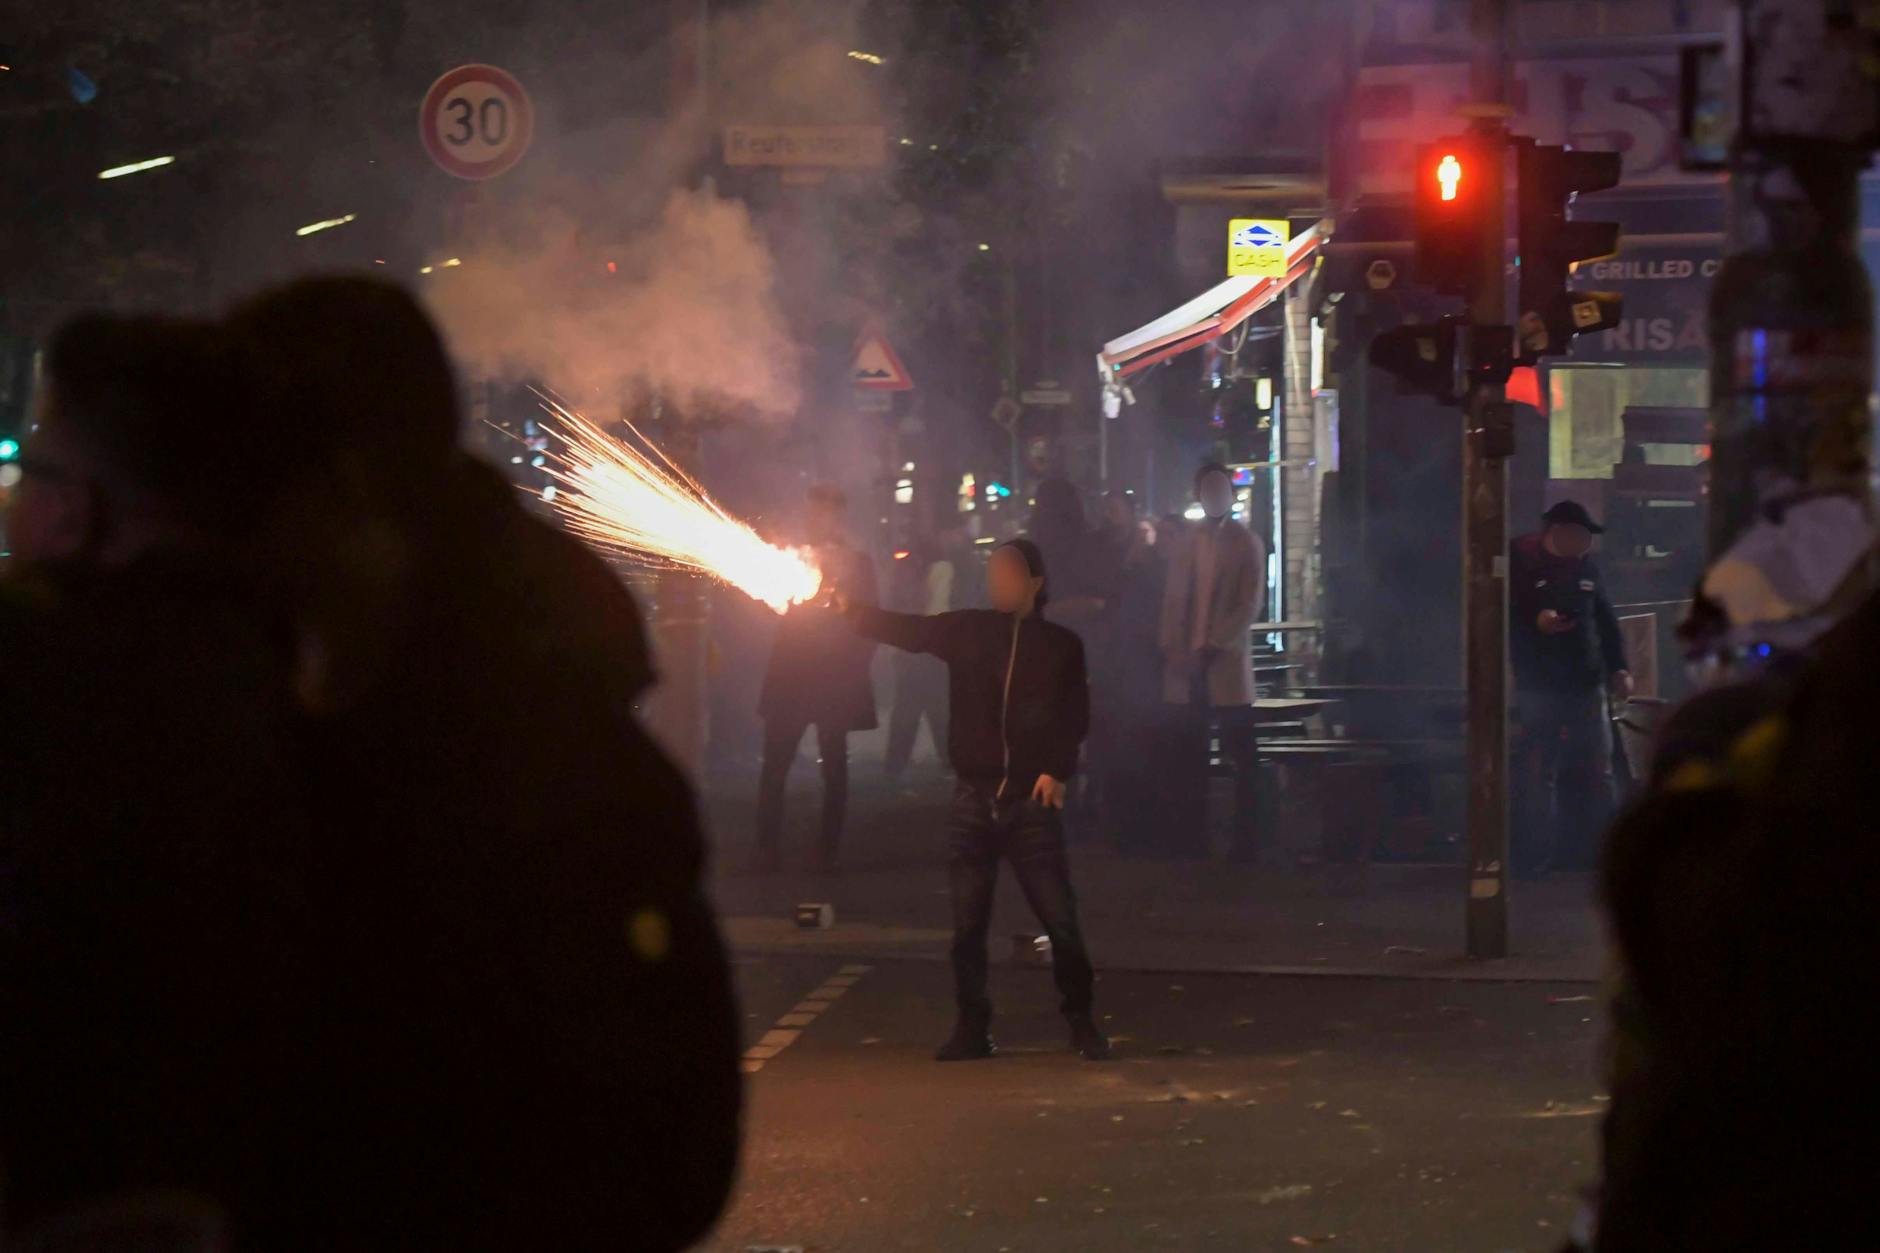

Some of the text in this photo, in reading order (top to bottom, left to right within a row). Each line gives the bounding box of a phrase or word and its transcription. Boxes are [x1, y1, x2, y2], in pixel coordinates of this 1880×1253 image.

[446, 97, 506, 146] 30
[1234, 252, 1282, 268] CASH
[1591, 260, 1694, 280] GRILLED
